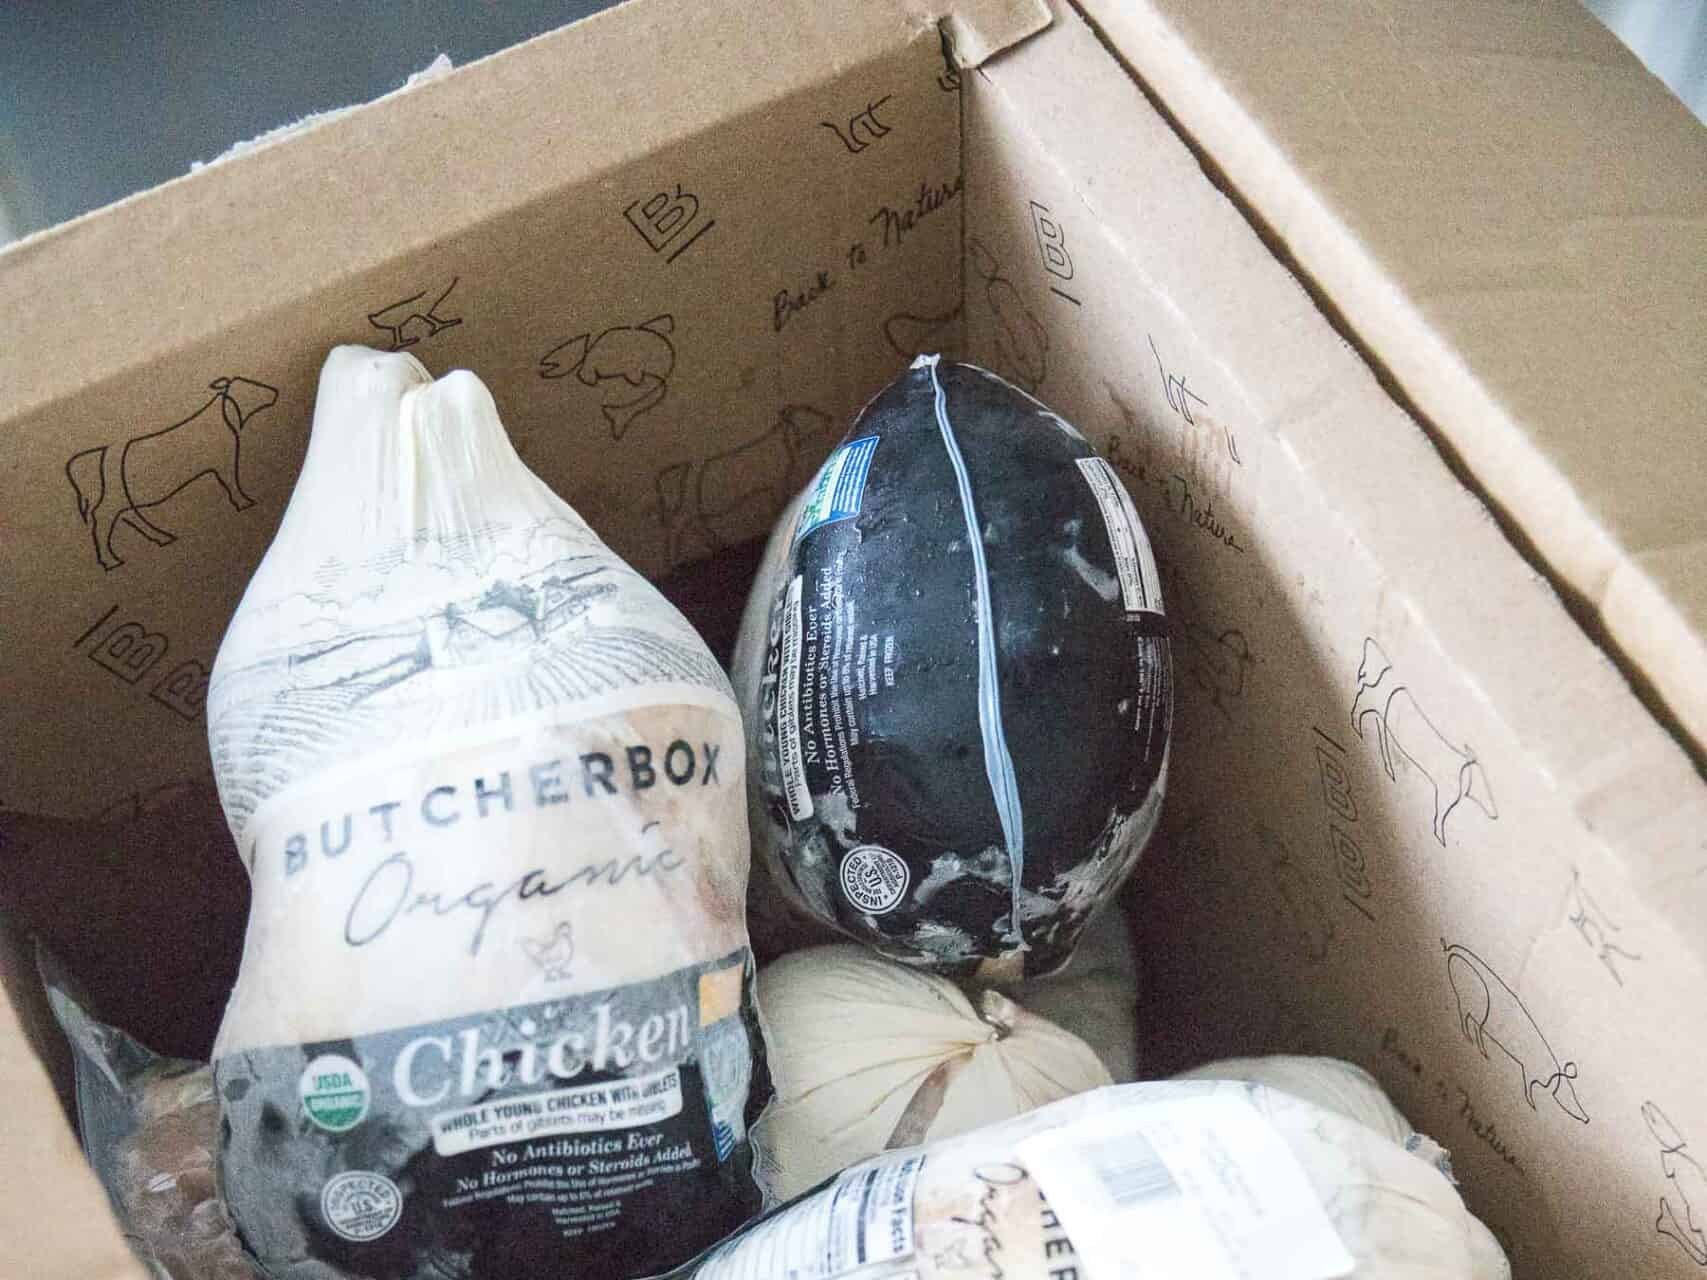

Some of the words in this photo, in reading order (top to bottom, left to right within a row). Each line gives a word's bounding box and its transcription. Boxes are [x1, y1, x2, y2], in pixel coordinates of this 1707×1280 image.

[821, 567, 832, 609] Added
[807, 605, 818, 642] Ever
[818, 613, 831, 672] Steroids
[803, 645, 817, 734] Antibiotics
[820, 673, 827, 688] or
[807, 740, 819, 764] No
[820, 692, 837, 772] Hormones
[832, 775, 843, 795] No
[283, 739, 720, 877] BUTCHERBOX
[344, 821, 688, 957] Organic
[847, 856, 882, 906] INSPECTED
[393, 1003, 692, 1109] Chicken
[546, 1092, 607, 1112] CHICKEN
[491, 1148, 518, 1167] No
[523, 1138, 622, 1162] Antibiotics
[626, 1132, 665, 1151] Ever
[456, 1177, 479, 1194] No
[483, 1165, 563, 1187] Hormones
[566, 1164, 586, 1177] or
[587, 1153, 650, 1176] Steroids
